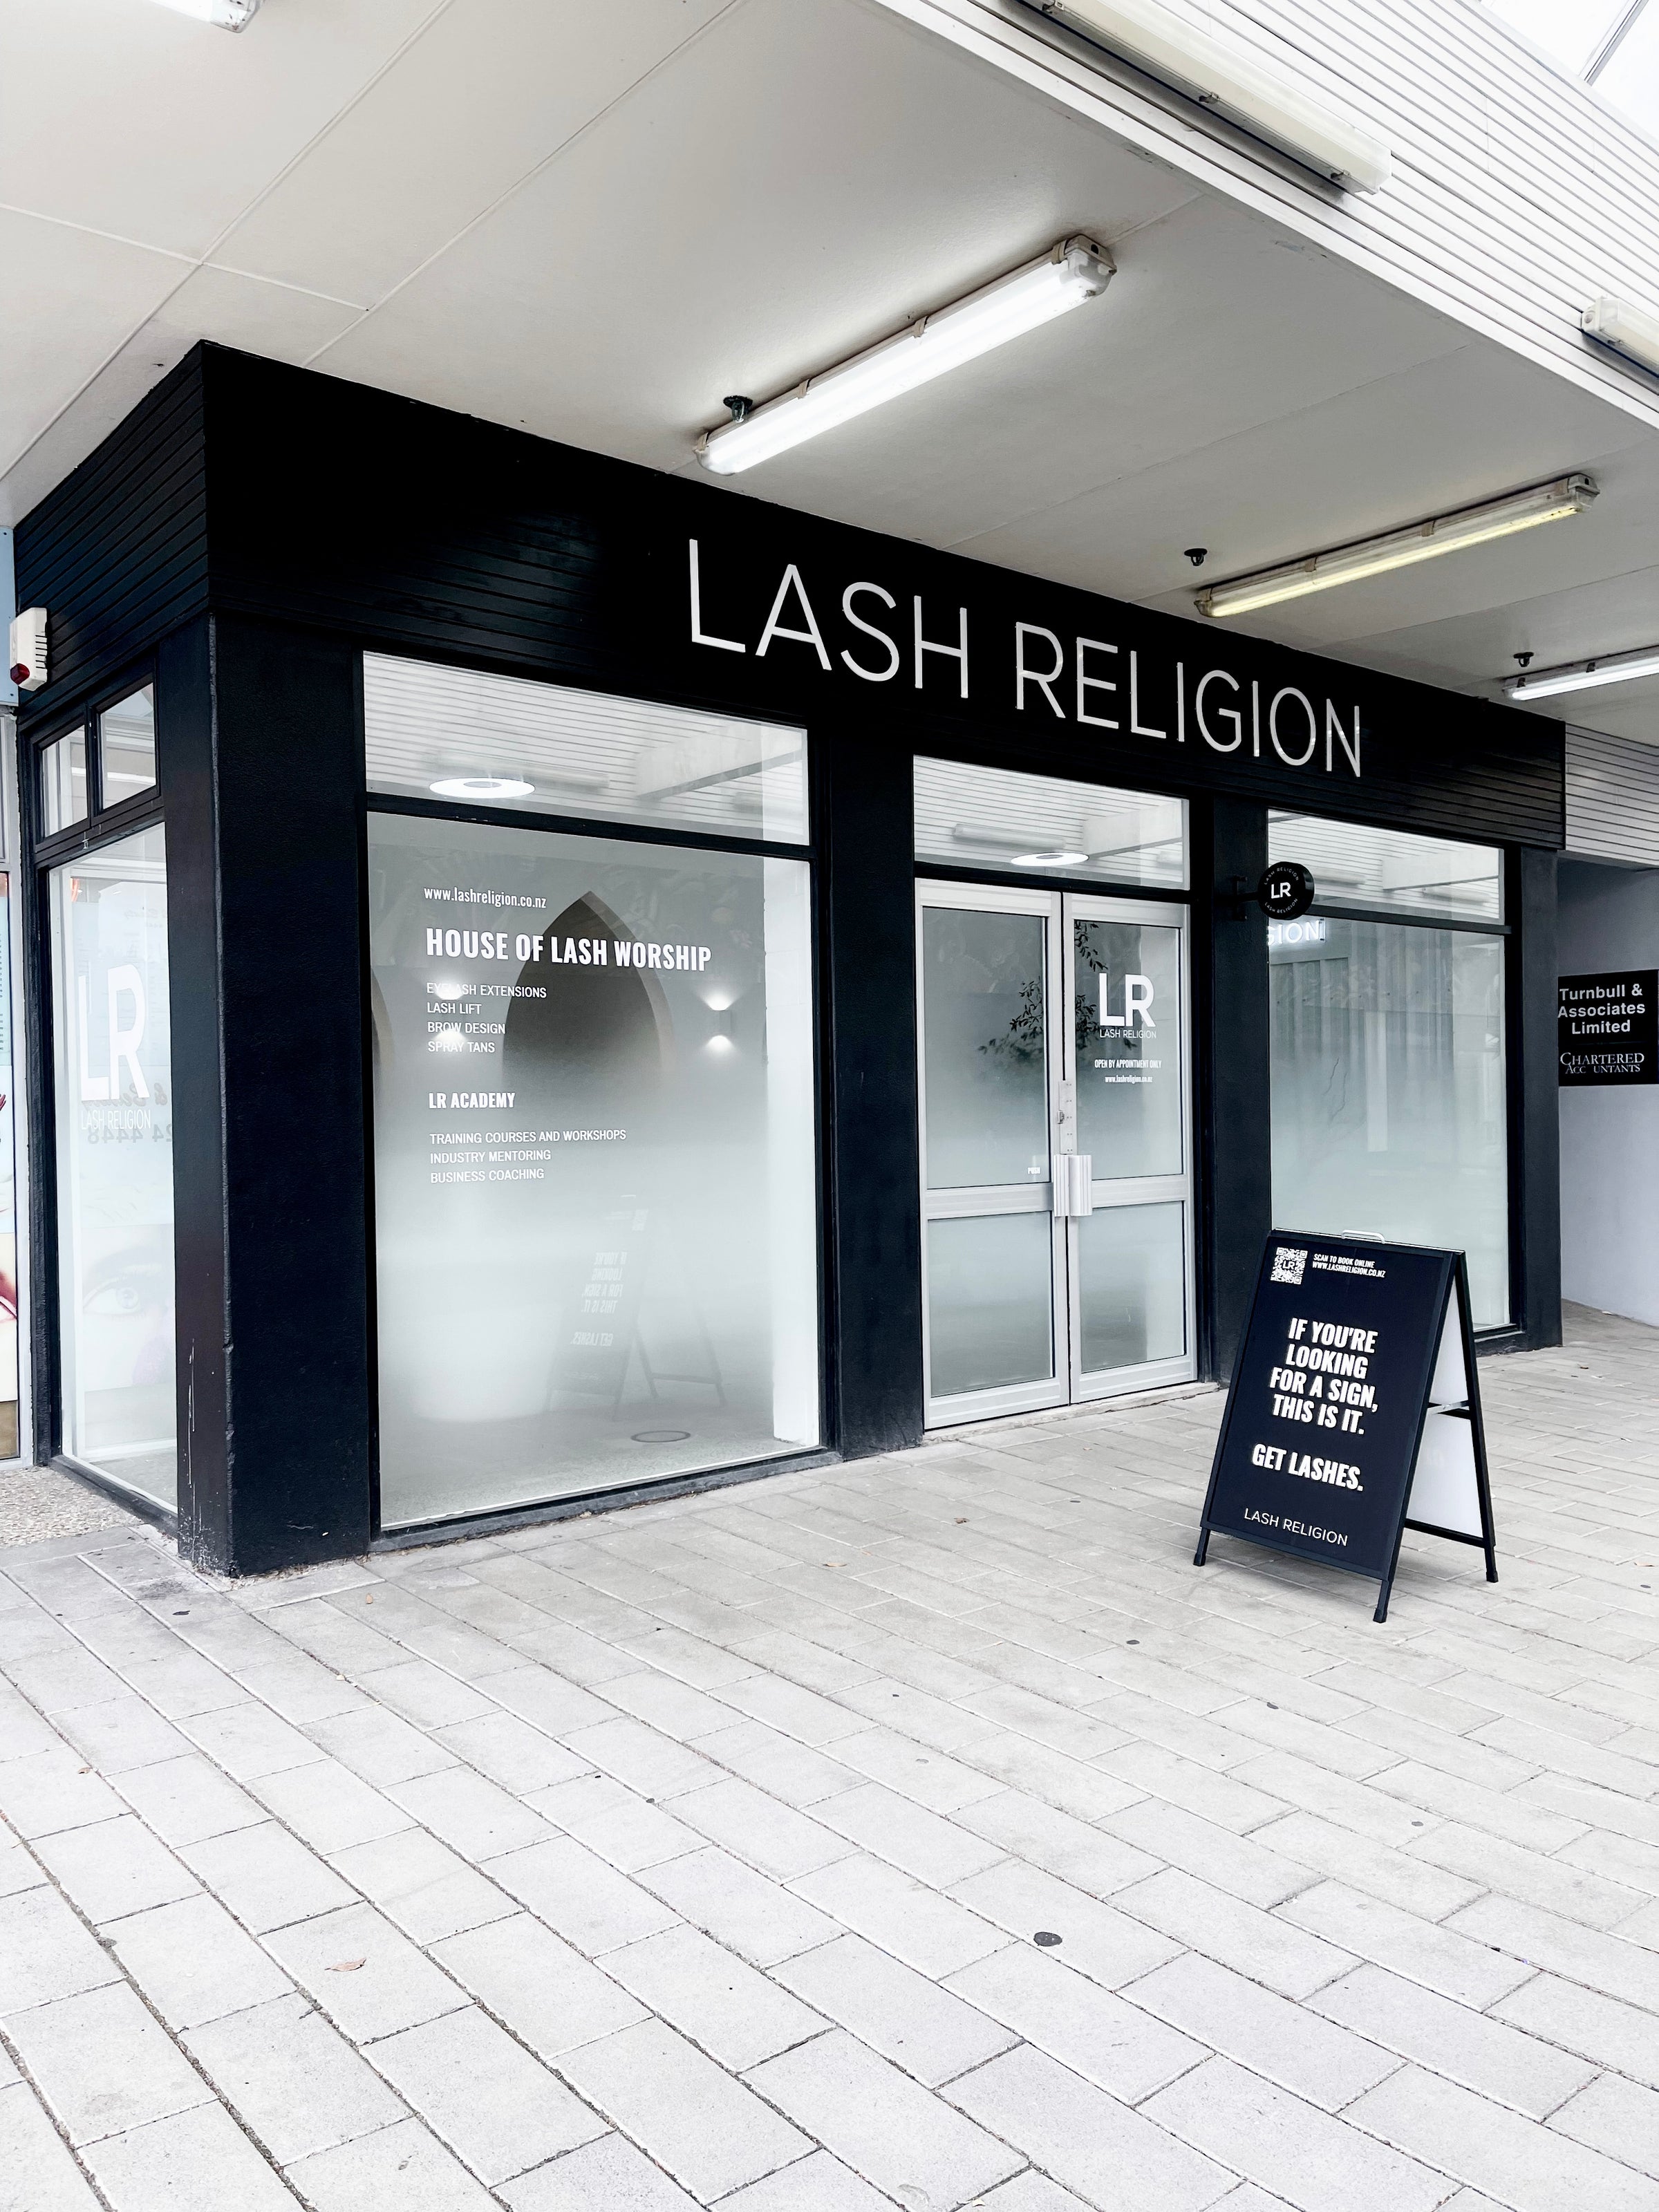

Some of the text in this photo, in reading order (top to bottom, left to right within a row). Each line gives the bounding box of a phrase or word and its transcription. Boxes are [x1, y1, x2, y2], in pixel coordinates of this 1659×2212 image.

[689, 538, 1360, 777] LASH RELIGION
[424, 887, 547, 908] www.lashreligion.co.nz
[1271, 882, 1291, 899] LR
[426, 928, 711, 971] HOUSE OF LASH WORSHIP
[427, 982, 547, 998] EYASH EXTENSIONS
[1559, 984, 1643, 1001] Turnbull &
[1099, 973, 1156, 1027] LR
[427, 1002, 482, 1015] LASH LIFT
[1557, 1002, 1645, 1018] Associates
[79, 964, 150, 1101] LR
[427, 1022, 505, 1034] BROW DESIGN
[1100, 1029, 1156, 1038] LASH RELIGION
[1572, 1020, 1631, 1034] Limited
[429, 1041, 495, 1053] SPRAY TANS
[1094, 1059, 1162, 1069] OPEN BY APPOINTMENT ONLY
[1560, 1052, 1644, 1065] CHARTERED
[429, 1092, 515, 1109] LR ACADEMY
[82, 1109, 151, 1130] LASH RELIGION
[429, 1129, 626, 1144] TRAINING COURSES AND WORKSHOPS
[430, 1150, 551, 1164] INDUSTRY MENTORING
[430, 1168, 544, 1183] BUSINESS COACHING
[1282, 1260, 1295, 1271] LR
[1313, 1253, 1376, 1268] SCAN TO BOOK ONLINE
[1312, 1262, 1386, 1277] WWW.LASHRELIGION.CO.NZ
[1288, 1317, 1379, 1353] IF YOU'RE
[1285, 1344, 1368, 1379] LOOKING
[1269, 1367, 1379, 1413] FOR A SIGN,
[1272, 1394, 1365, 1435] THIS IS IT.
[1252, 1443, 1364, 1492] GET LASHES.
[1244, 1508, 1348, 1547] LASH RELIGION
